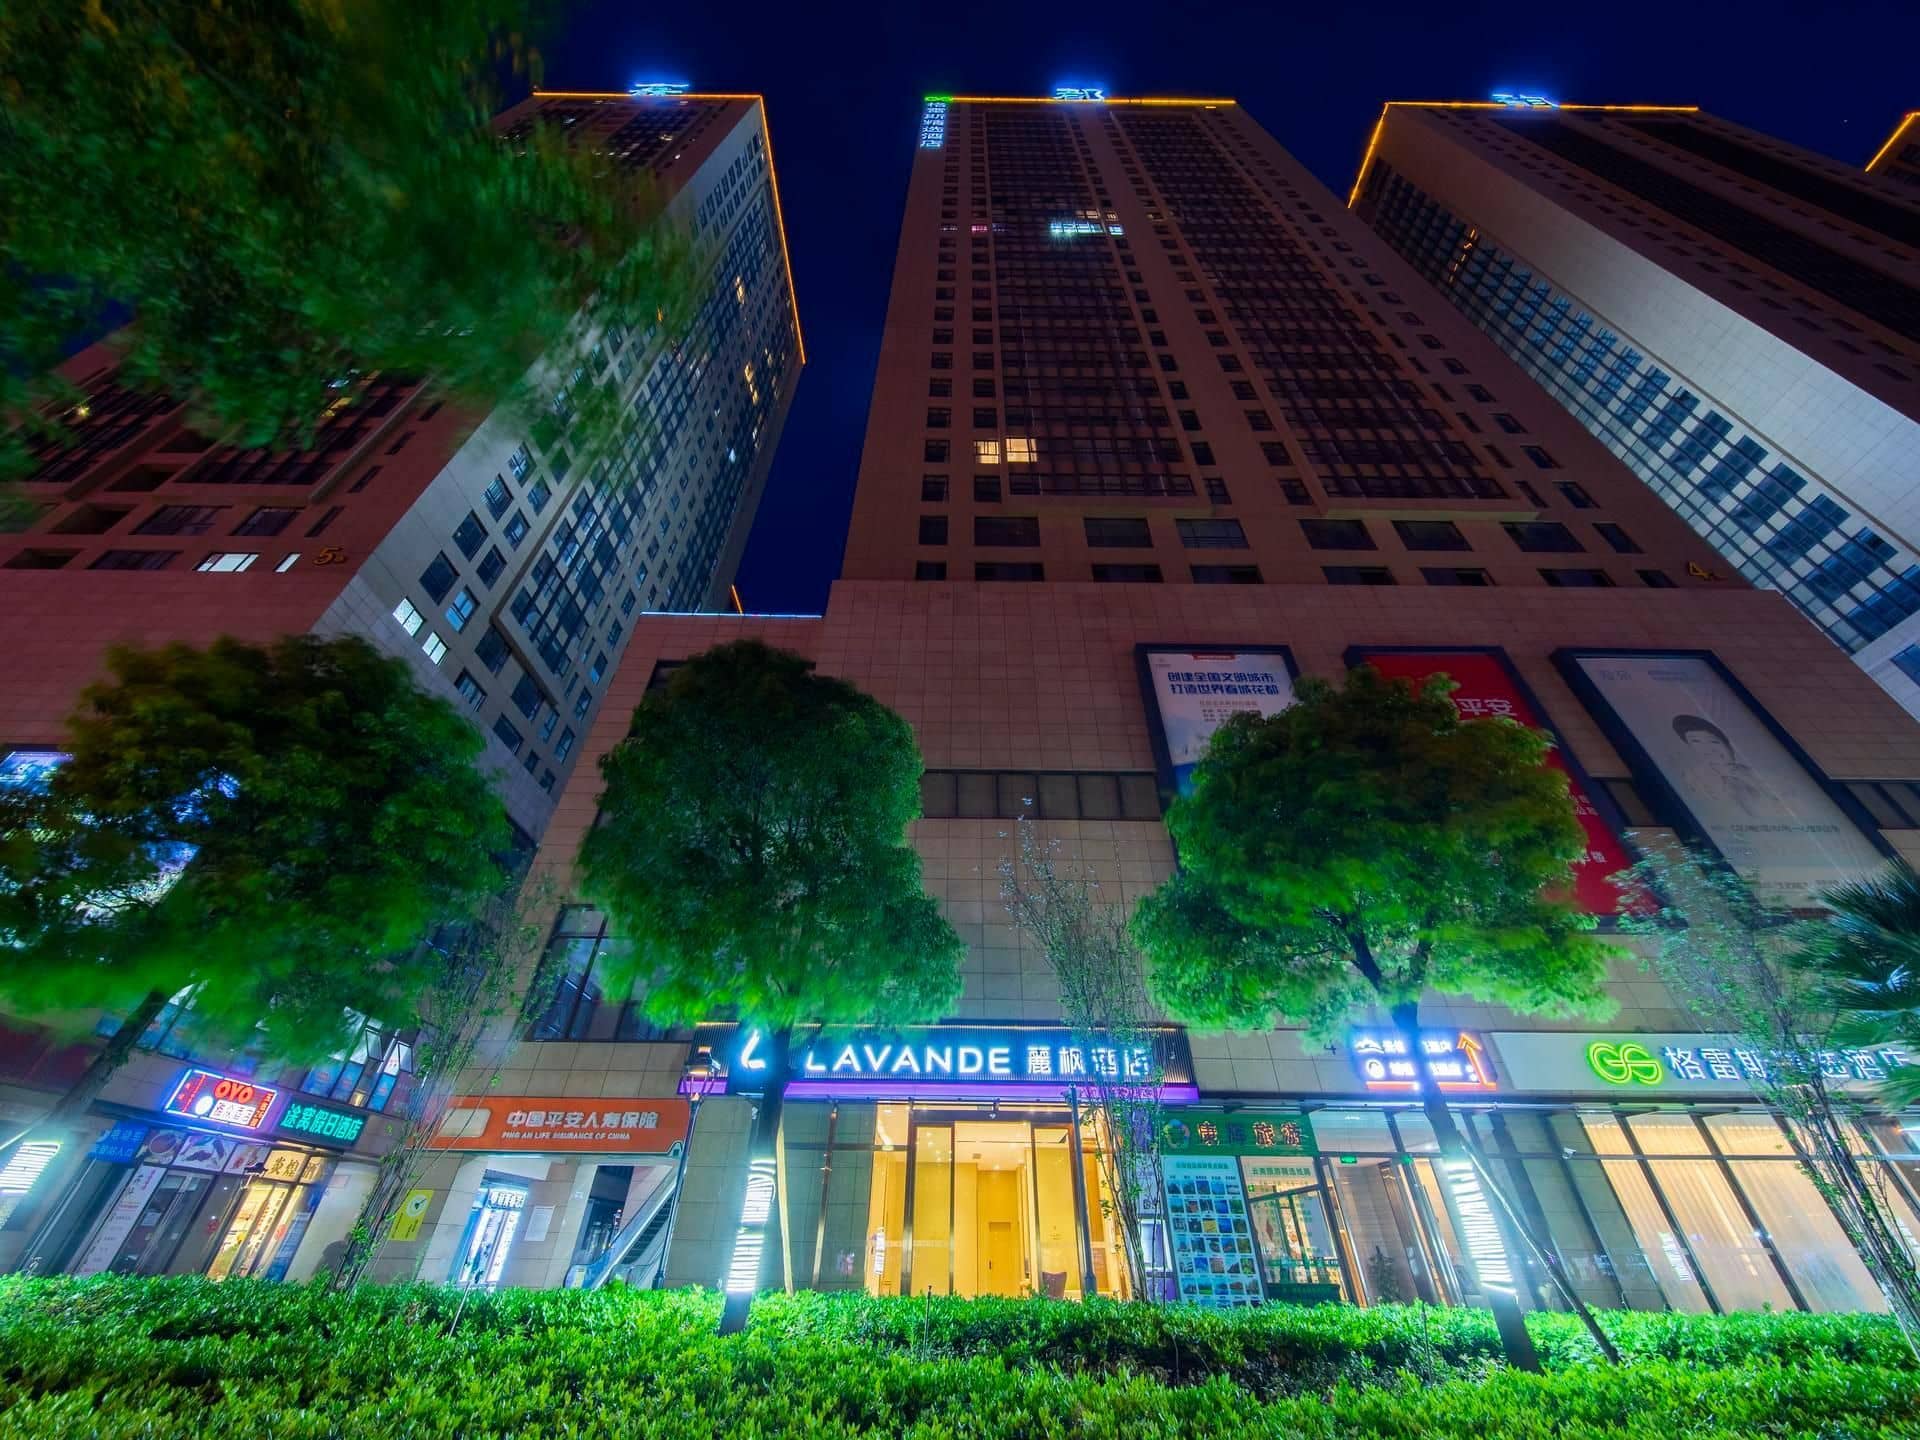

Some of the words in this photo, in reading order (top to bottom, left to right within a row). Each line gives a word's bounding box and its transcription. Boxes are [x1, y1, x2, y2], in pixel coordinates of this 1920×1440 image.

[1167, 671, 1275, 683] 创建全国文明城市
[805, 1044, 1011, 1073] LAVANDE
[1664, 1046, 1911, 1081] 格雷斯选酒
[214, 1080, 256, 1105] OYO
[506, 1110, 659, 1129] 中国平安人寿保险
[501, 1131, 520, 1139] PING
[521, 1131, 533, 1139] AN
[534, 1131, 551, 1139] LIFE
[551, 1131, 594, 1140] INSURANCE
[594, 1131, 606, 1140] OF
[607, 1132, 630, 1140] CHINA
